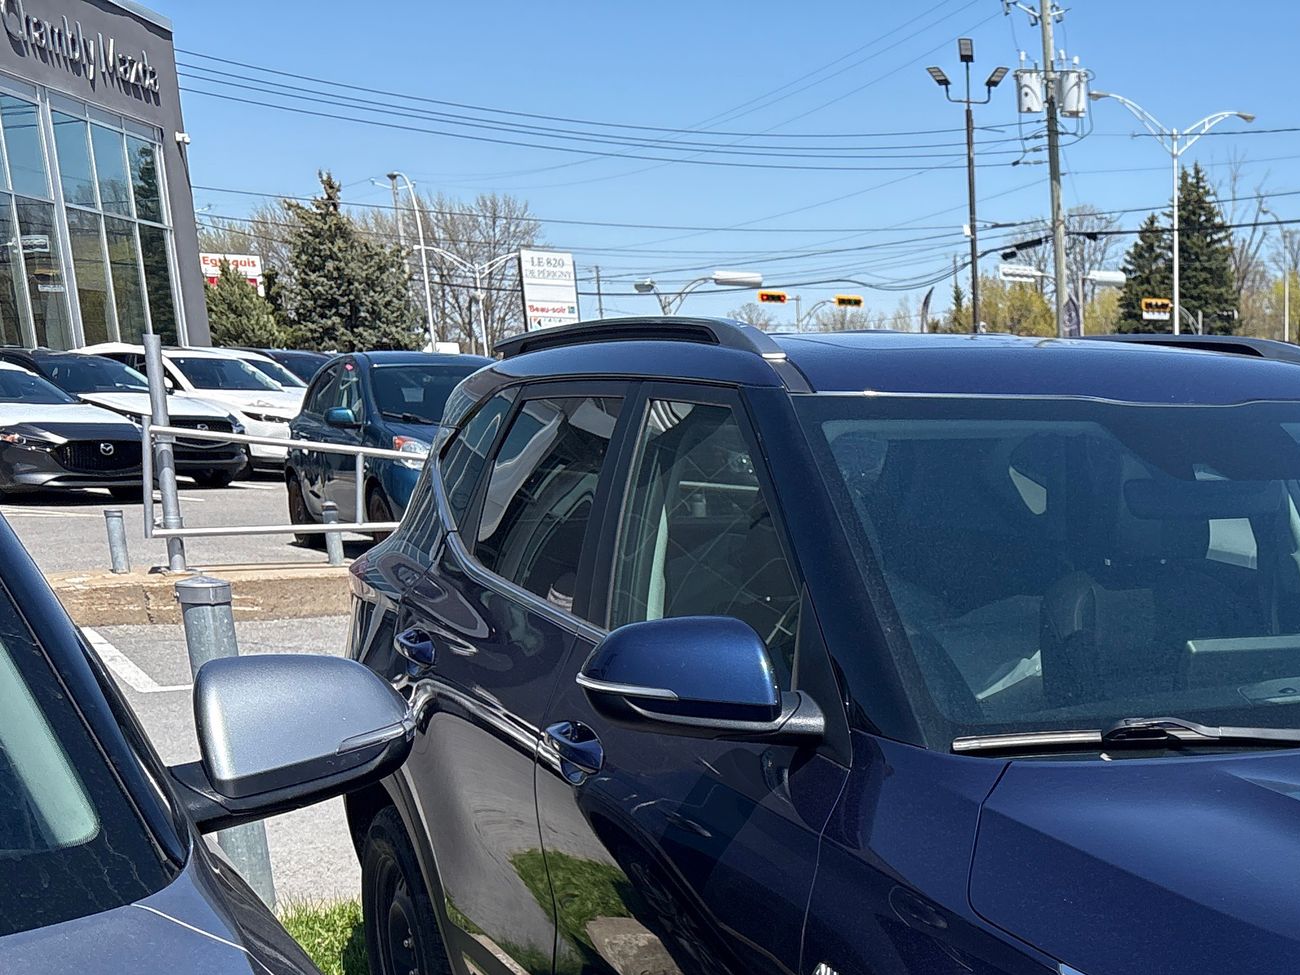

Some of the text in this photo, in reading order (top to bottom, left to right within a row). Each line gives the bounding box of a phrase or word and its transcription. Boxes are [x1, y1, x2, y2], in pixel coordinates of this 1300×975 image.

[97, 32, 160, 93] Mazda
[530, 256, 564, 268] LE 820
